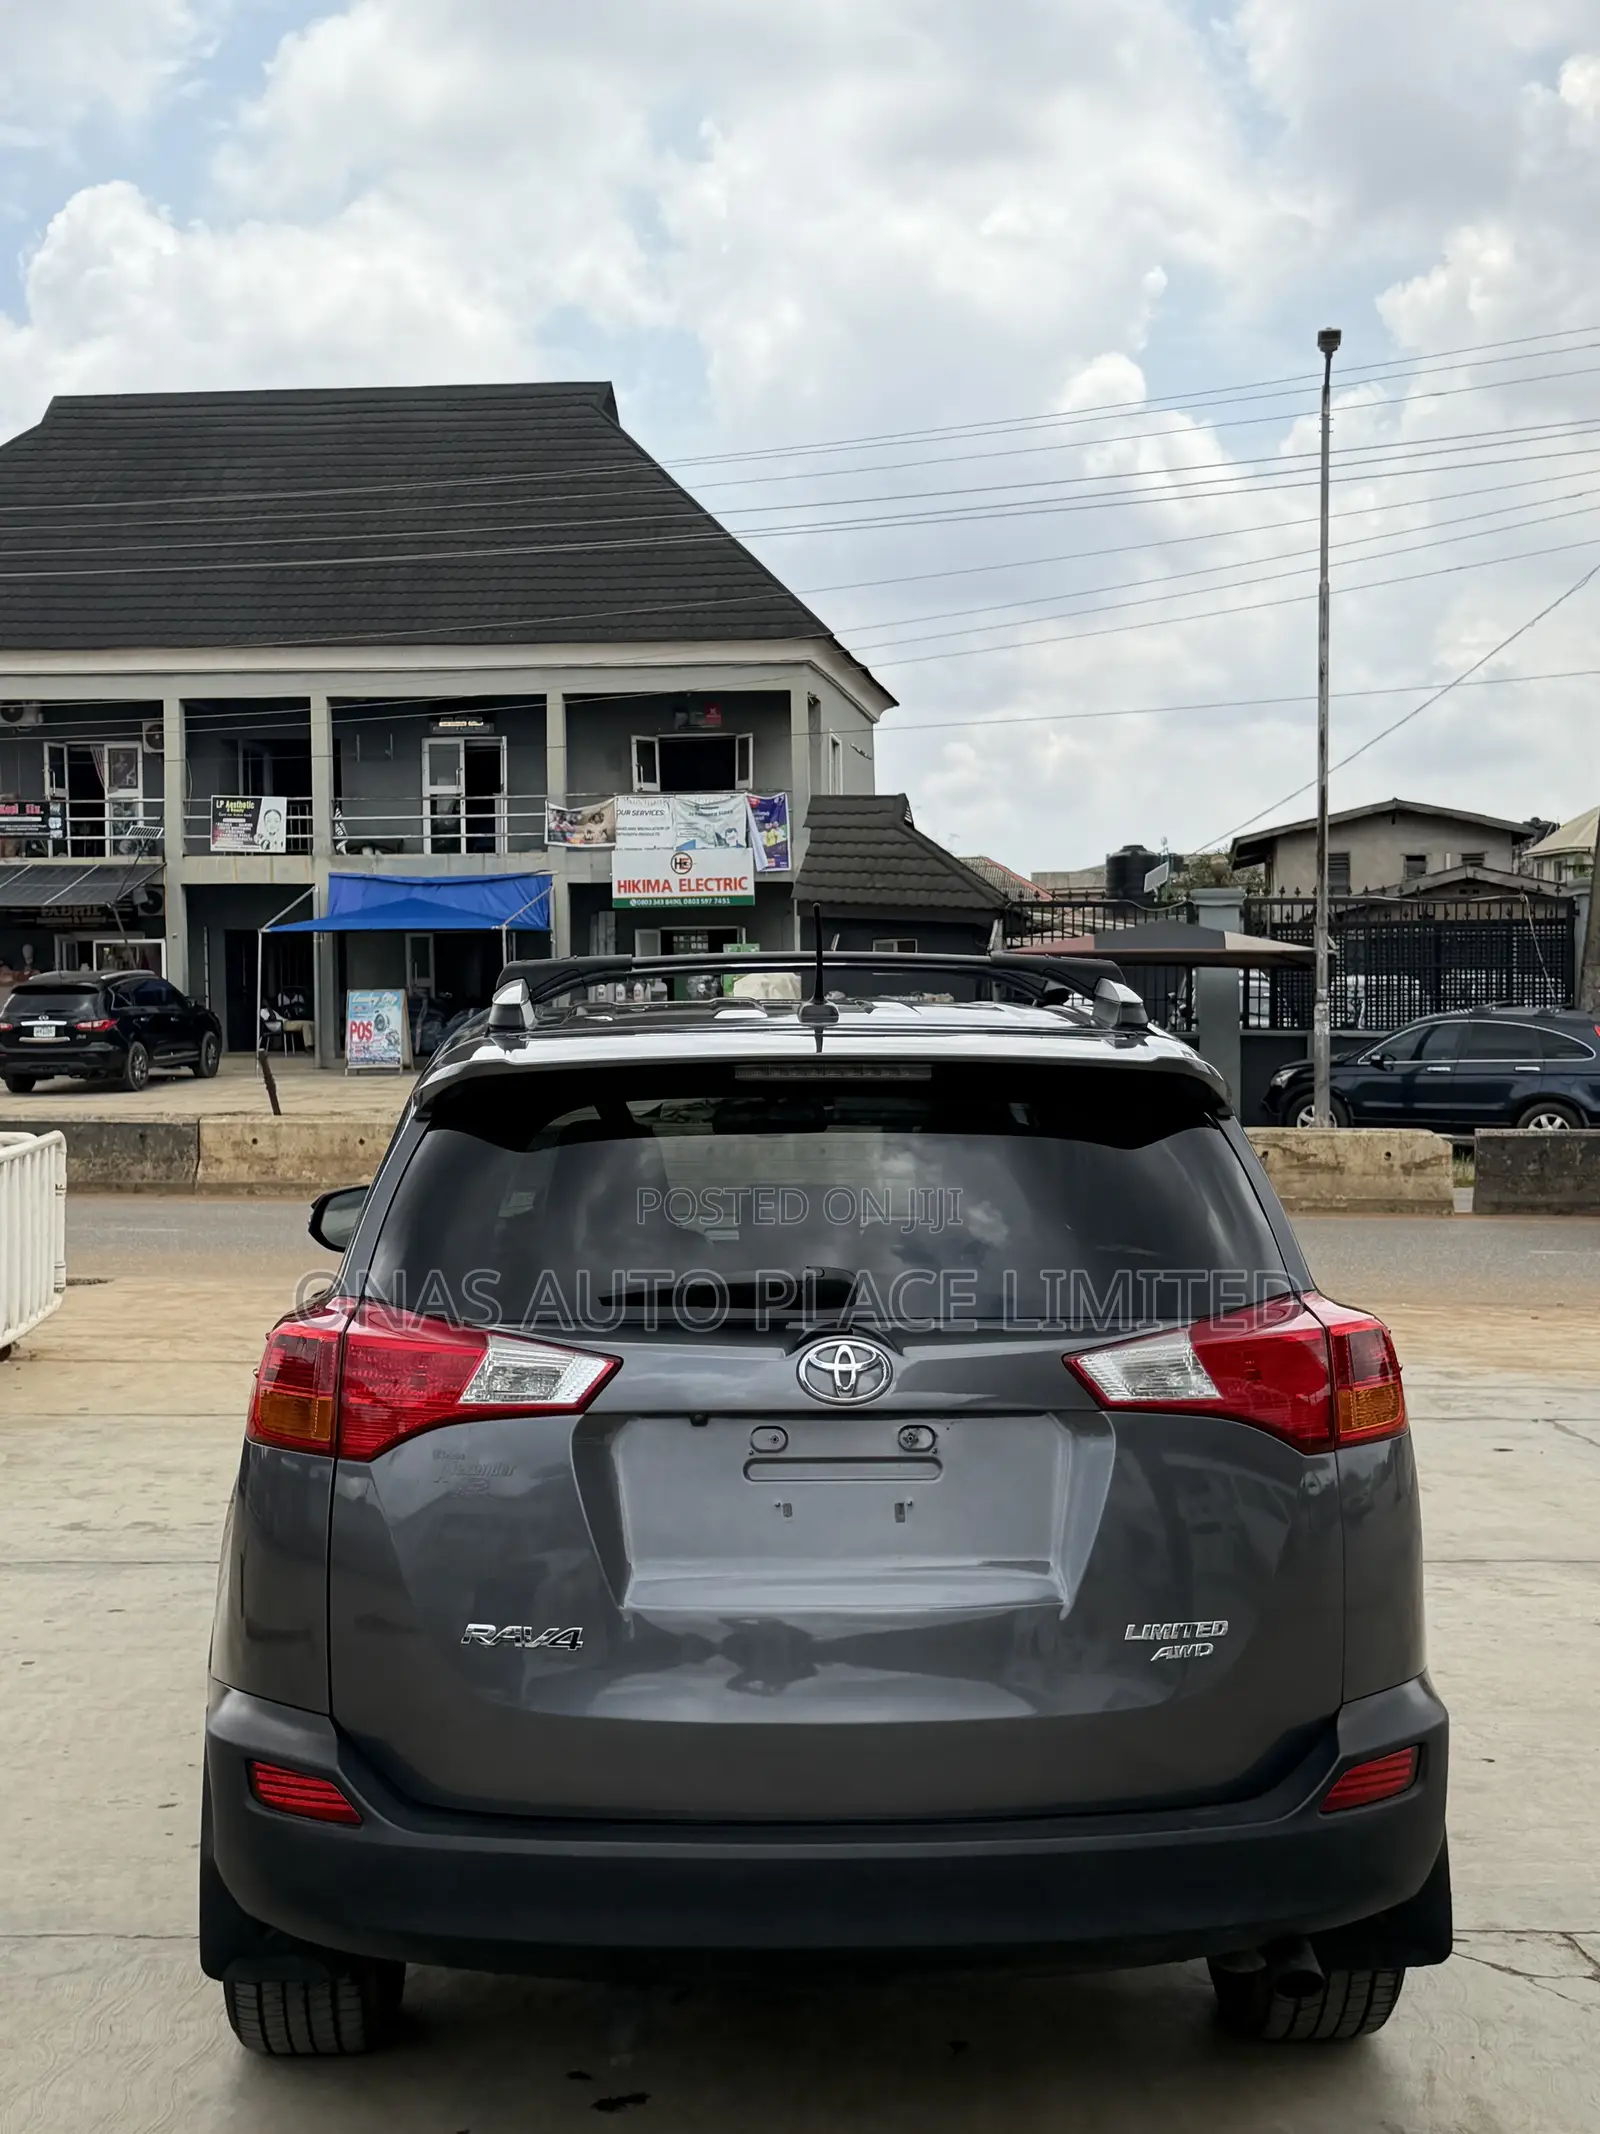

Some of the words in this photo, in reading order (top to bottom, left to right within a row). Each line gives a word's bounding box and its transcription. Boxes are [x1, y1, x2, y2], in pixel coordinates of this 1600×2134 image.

[617, 879, 673, 894] HIKIMA
[679, 876, 748, 892] ELECTRIC
[350, 1020, 373, 1041] POS
[461, 1623, 584, 1651] RAV4
[1124, 1620, 1229, 1641] LIMITED
[1150, 1642, 1214, 1661] AWD
